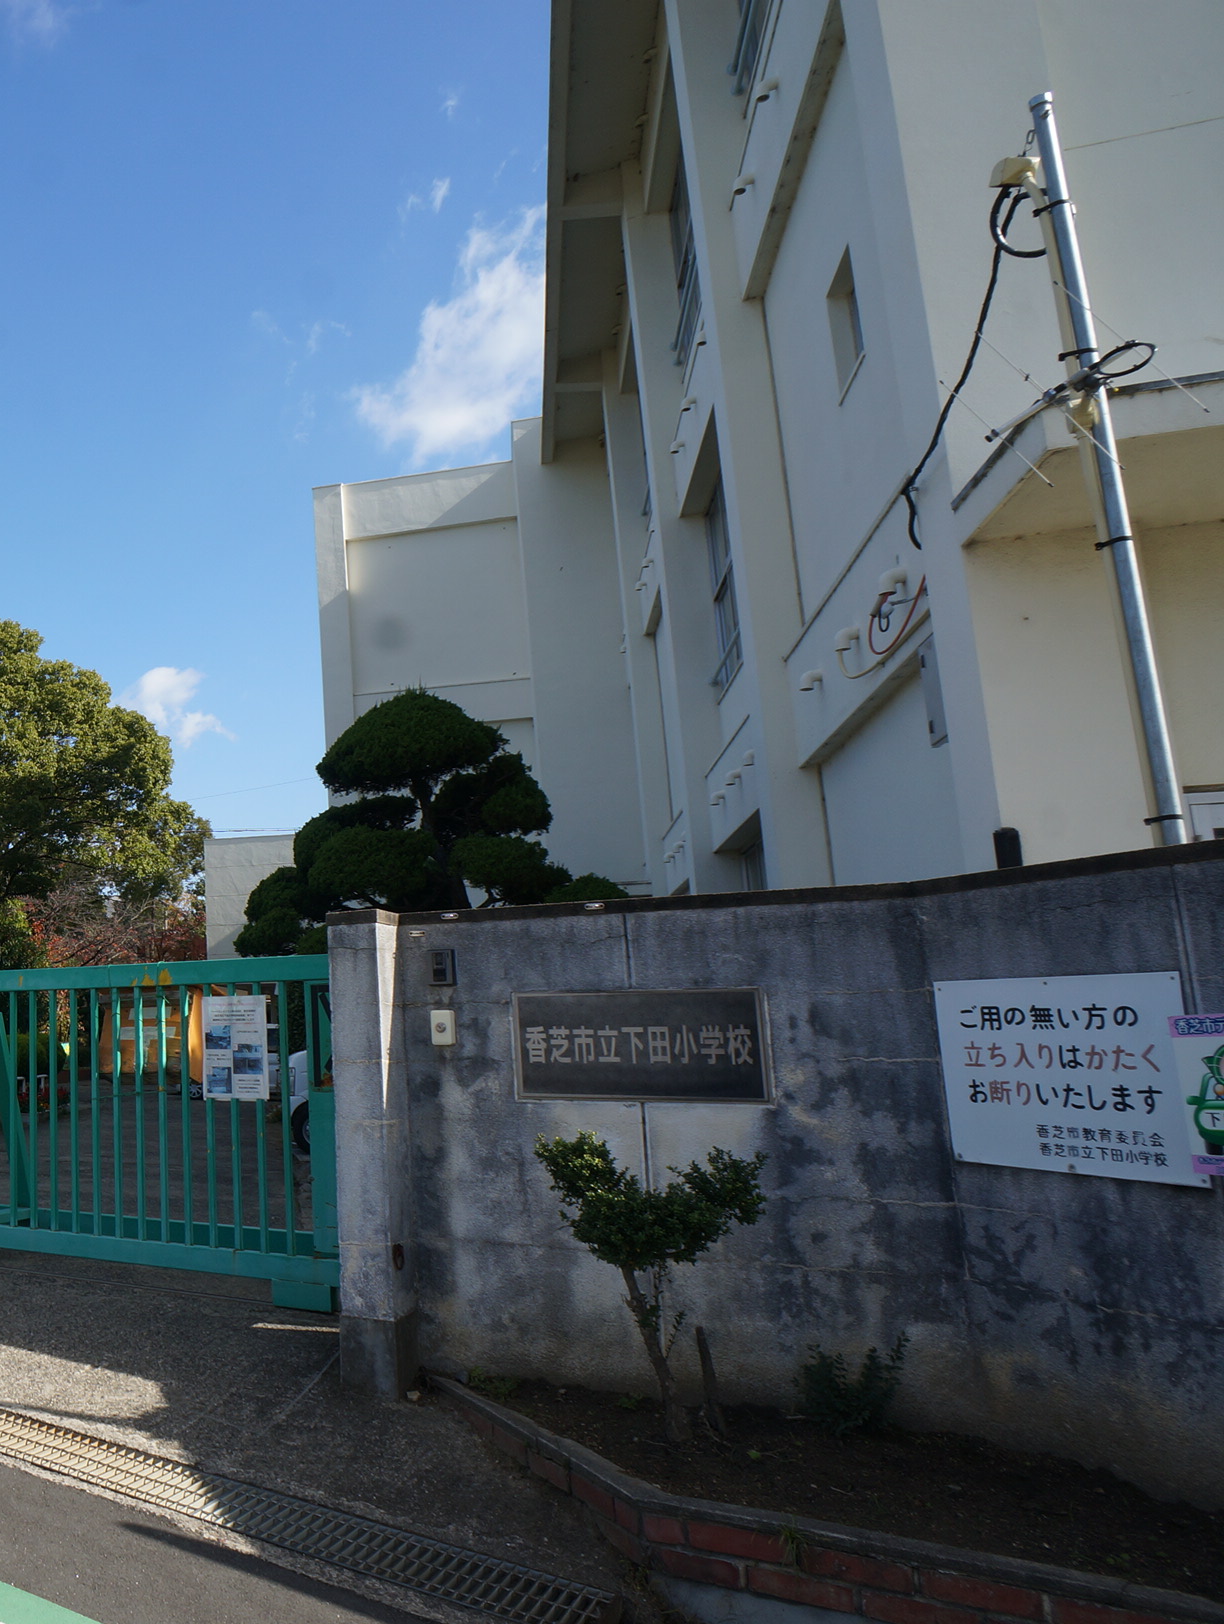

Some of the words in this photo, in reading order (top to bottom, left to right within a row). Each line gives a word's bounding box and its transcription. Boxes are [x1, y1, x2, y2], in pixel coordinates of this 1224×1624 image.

[959, 1003, 1138, 1031] ご用の無い方の
[526, 1024, 753, 1065] 香芝市立下田小学校
[963, 1041, 1161, 1073] 立ち入りはかたく
[968, 1079, 1163, 1114] お断りいたします
[1036, 1124, 1165, 1148] 香芝市教育委員会
[1039, 1142, 1169, 1167] 香芝市立下田小学校
